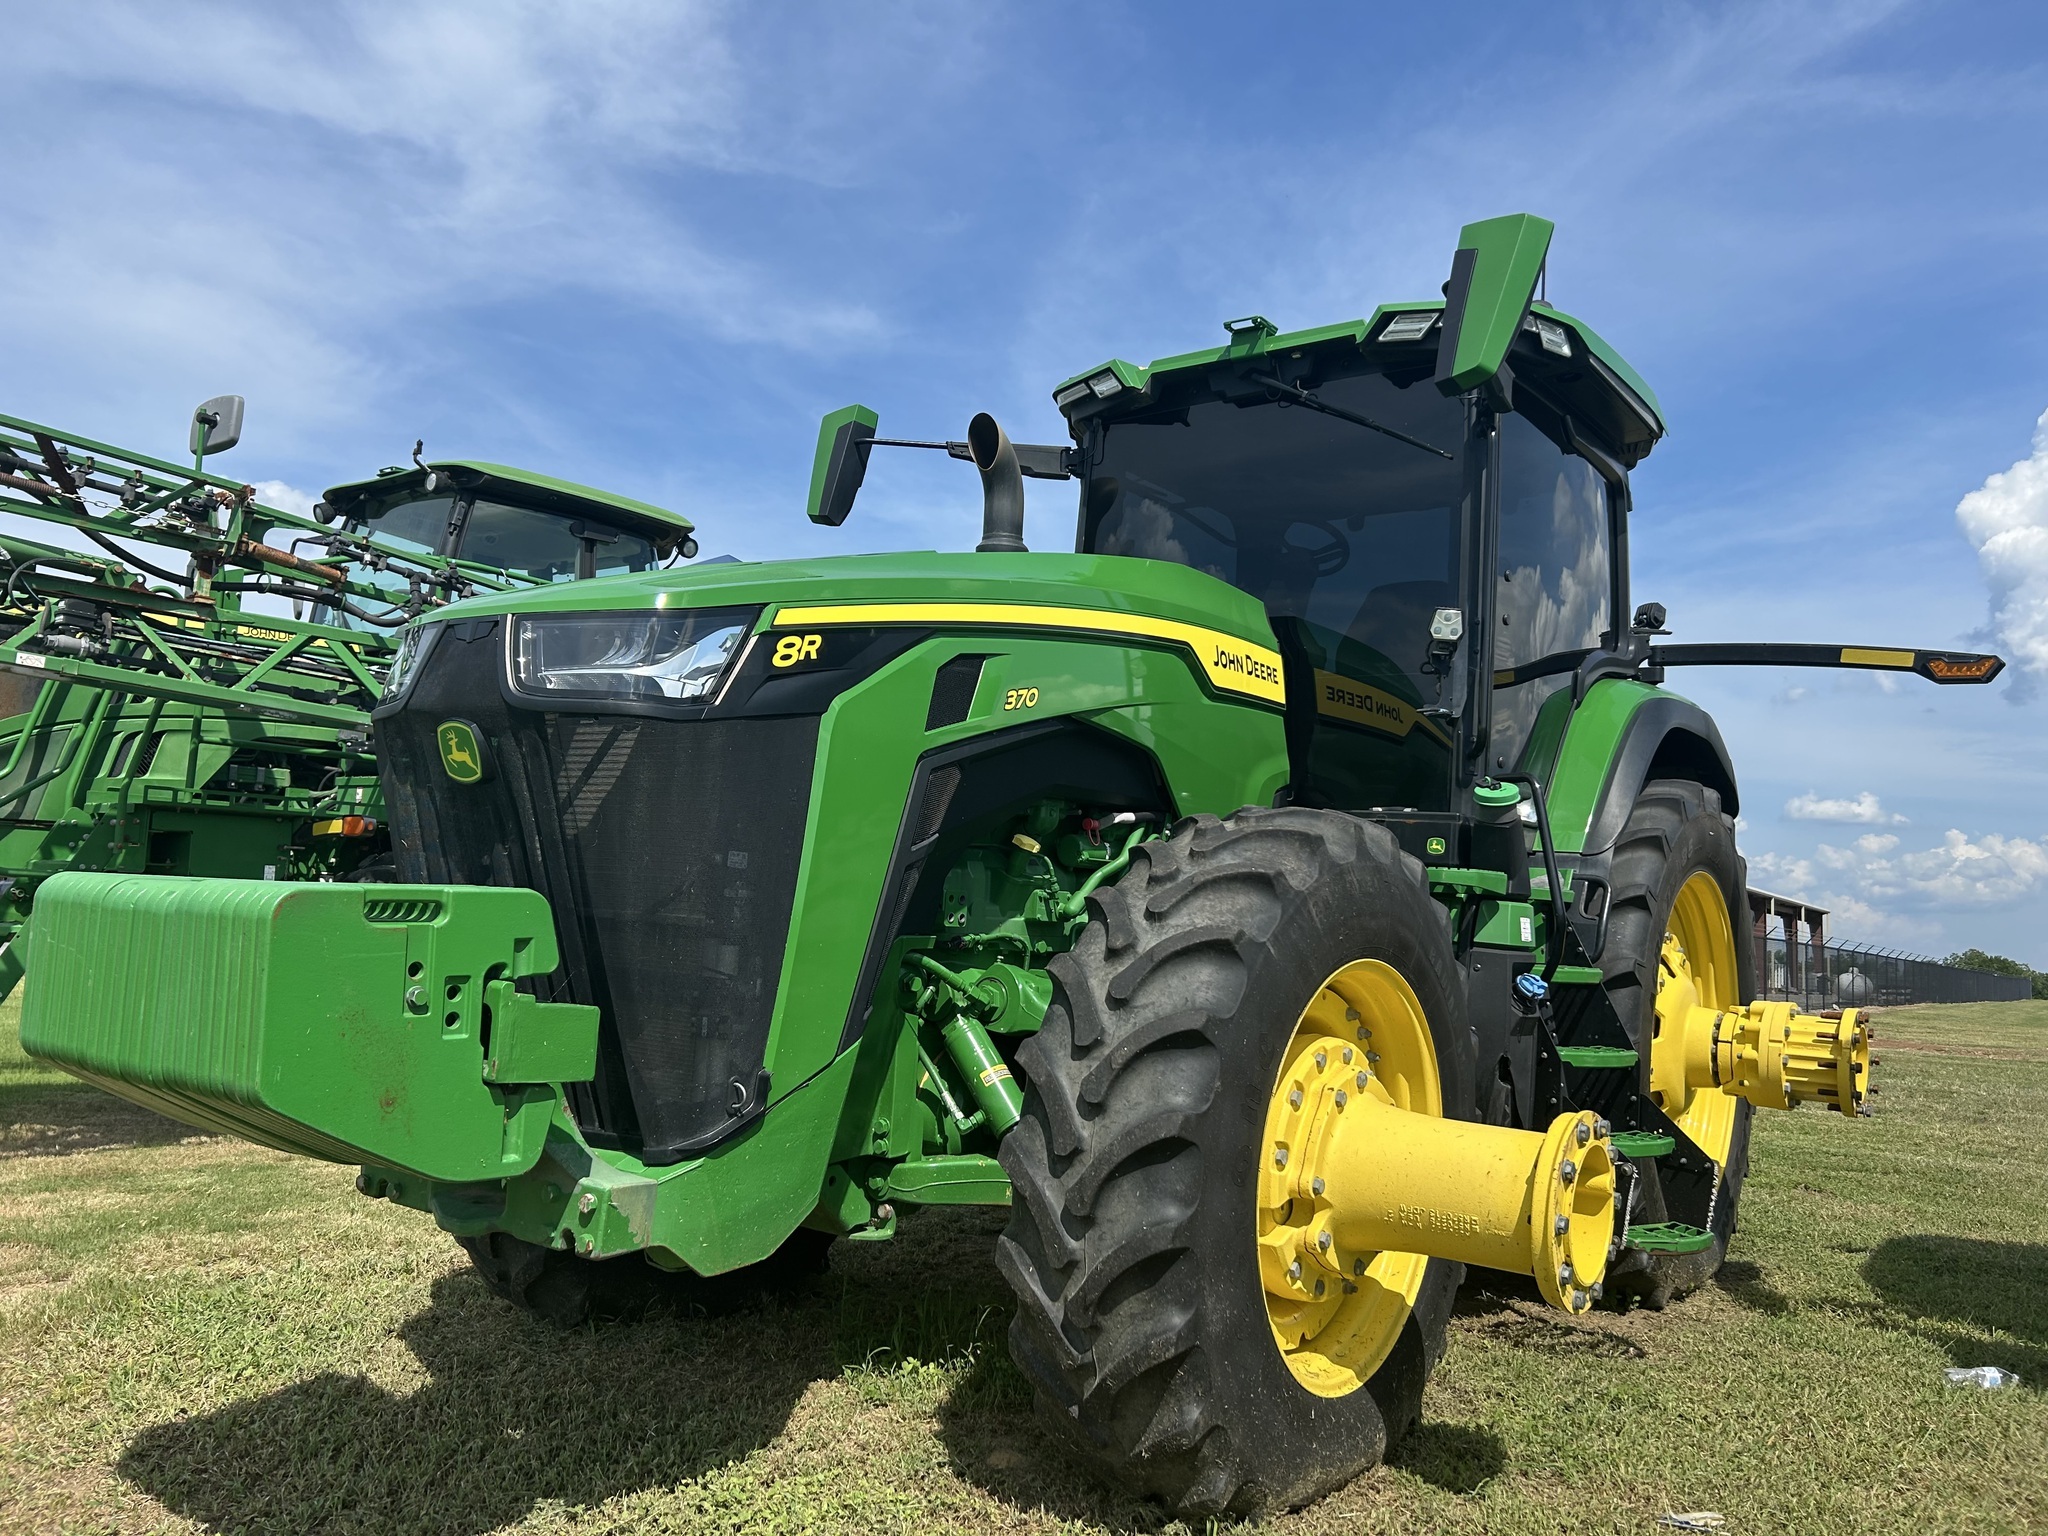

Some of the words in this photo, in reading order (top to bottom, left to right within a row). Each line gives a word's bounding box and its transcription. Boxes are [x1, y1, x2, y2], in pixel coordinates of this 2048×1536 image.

[243, 627, 276, 639] JOHN
[771, 634, 822, 668] 8R
[1213, 645, 1244, 674] JOHN
[1245, 655, 1279, 685] DEERE
[1004, 687, 1040, 711] 370
